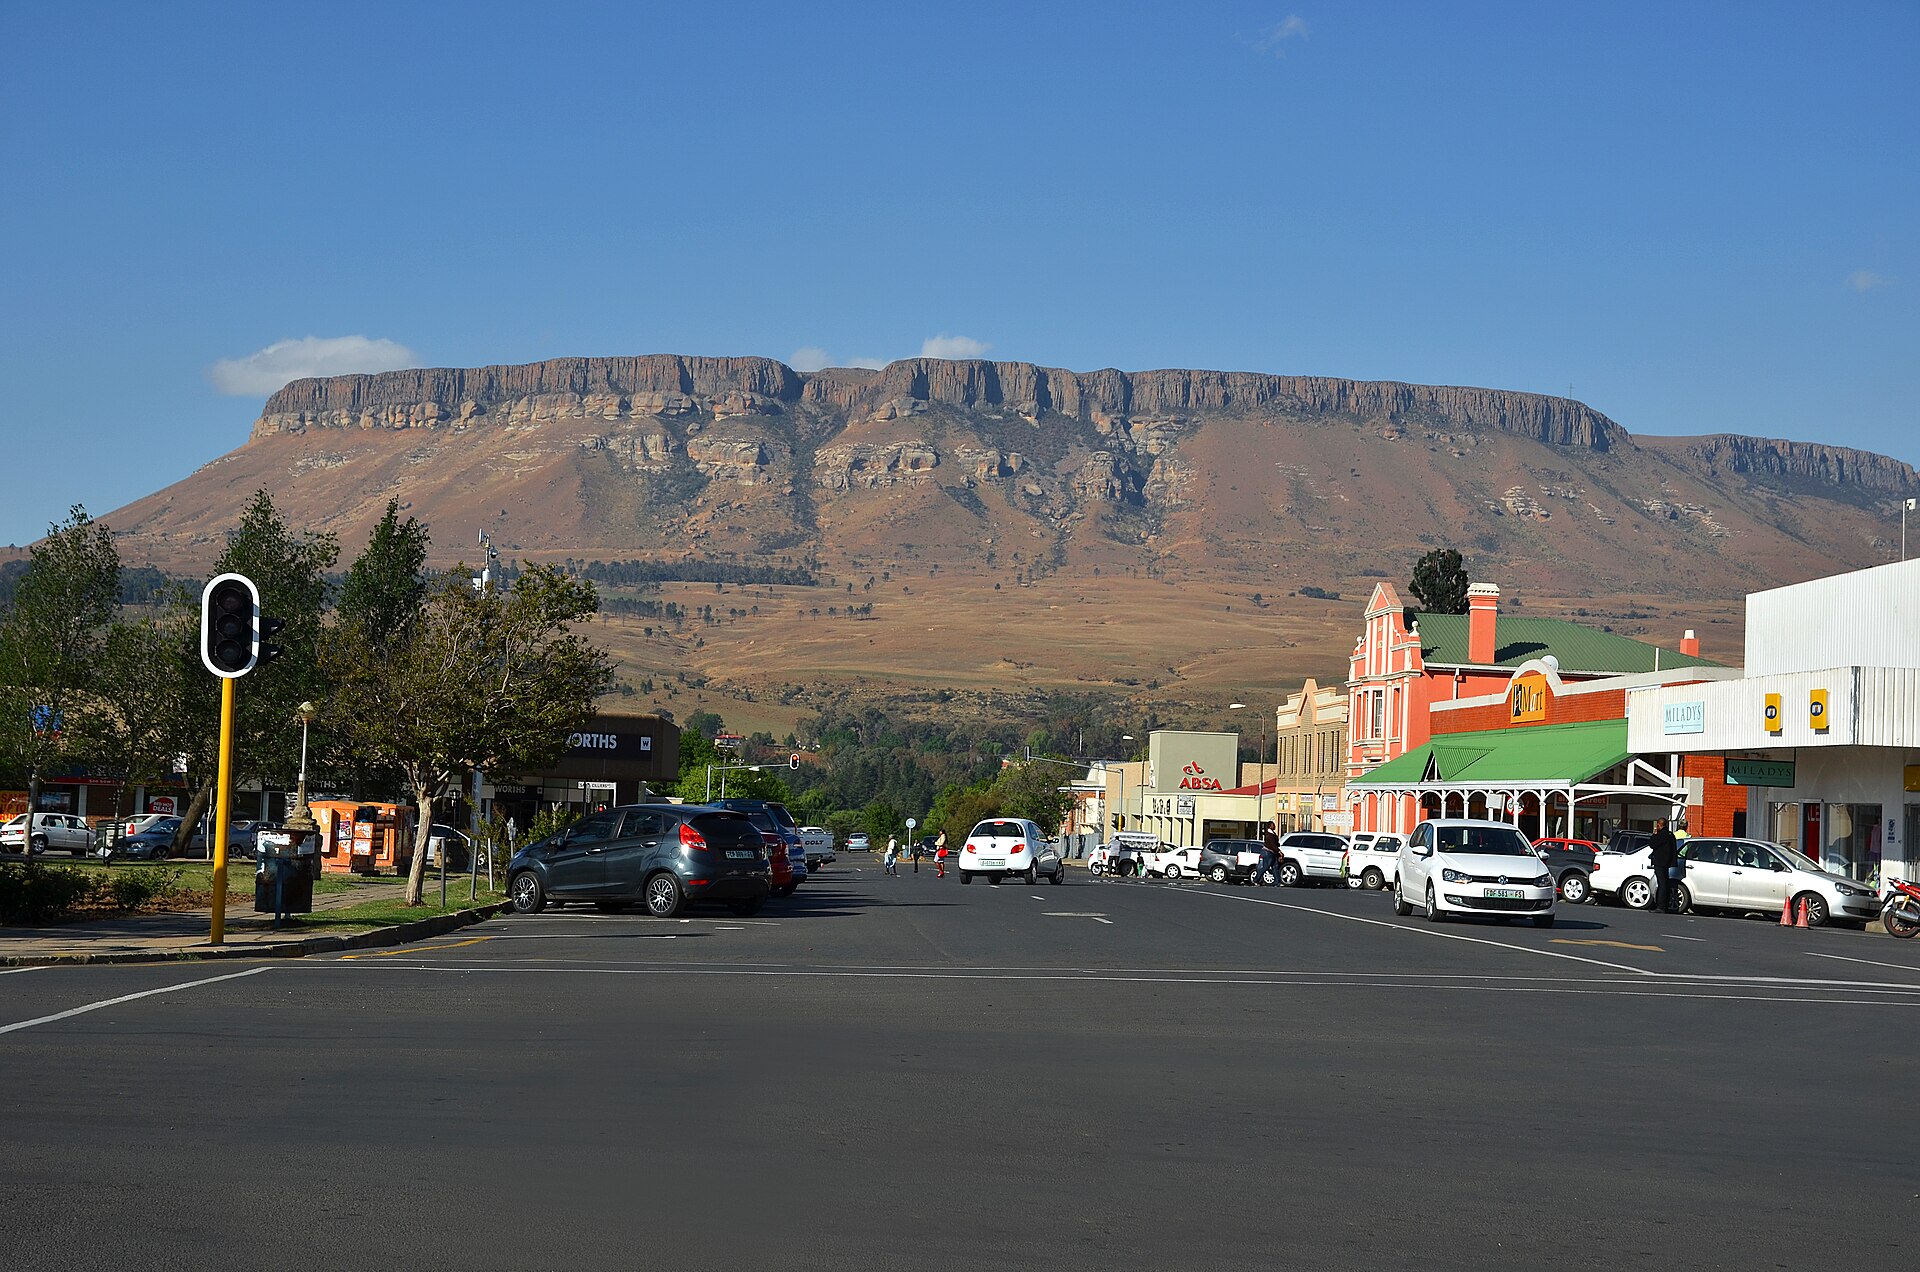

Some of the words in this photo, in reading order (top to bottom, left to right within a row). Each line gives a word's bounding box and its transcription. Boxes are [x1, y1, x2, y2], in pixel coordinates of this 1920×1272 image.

[1665, 705, 1702, 723] MILADYS
[566, 732, 618, 749] ORTHS
[1731, 766, 1792, 777] MILADYS
[1179, 777, 1222, 790] ABSA
